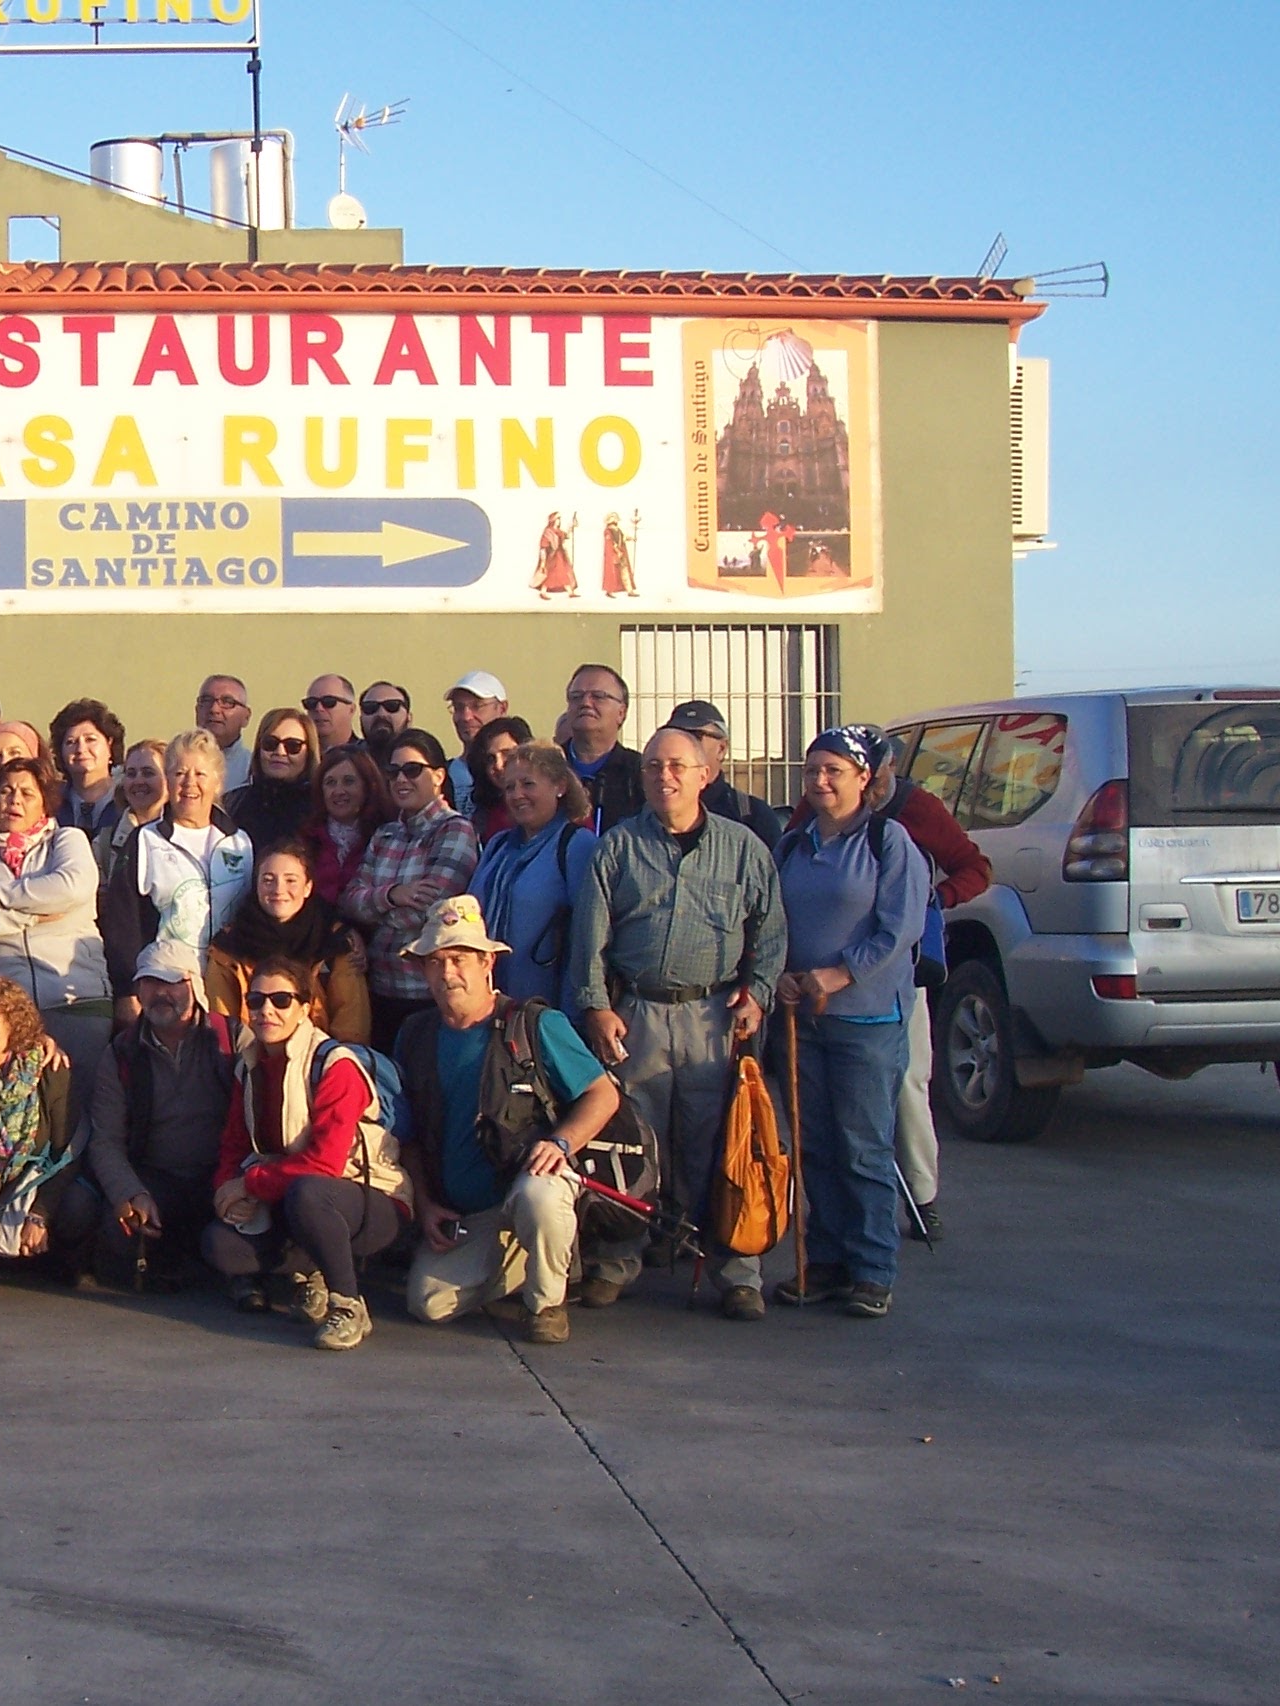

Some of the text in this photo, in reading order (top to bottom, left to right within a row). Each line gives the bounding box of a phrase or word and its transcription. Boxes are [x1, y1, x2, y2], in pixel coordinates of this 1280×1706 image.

[223, 415, 642, 489] RUFINO
[691, 360, 710, 553] Camino de Santiago
[58, 502, 249, 531] CAMINO
[132, 533, 176, 554] DE
[31, 557, 278, 587] SANTIAGO
[1253, 892, 1280, 915] 78
